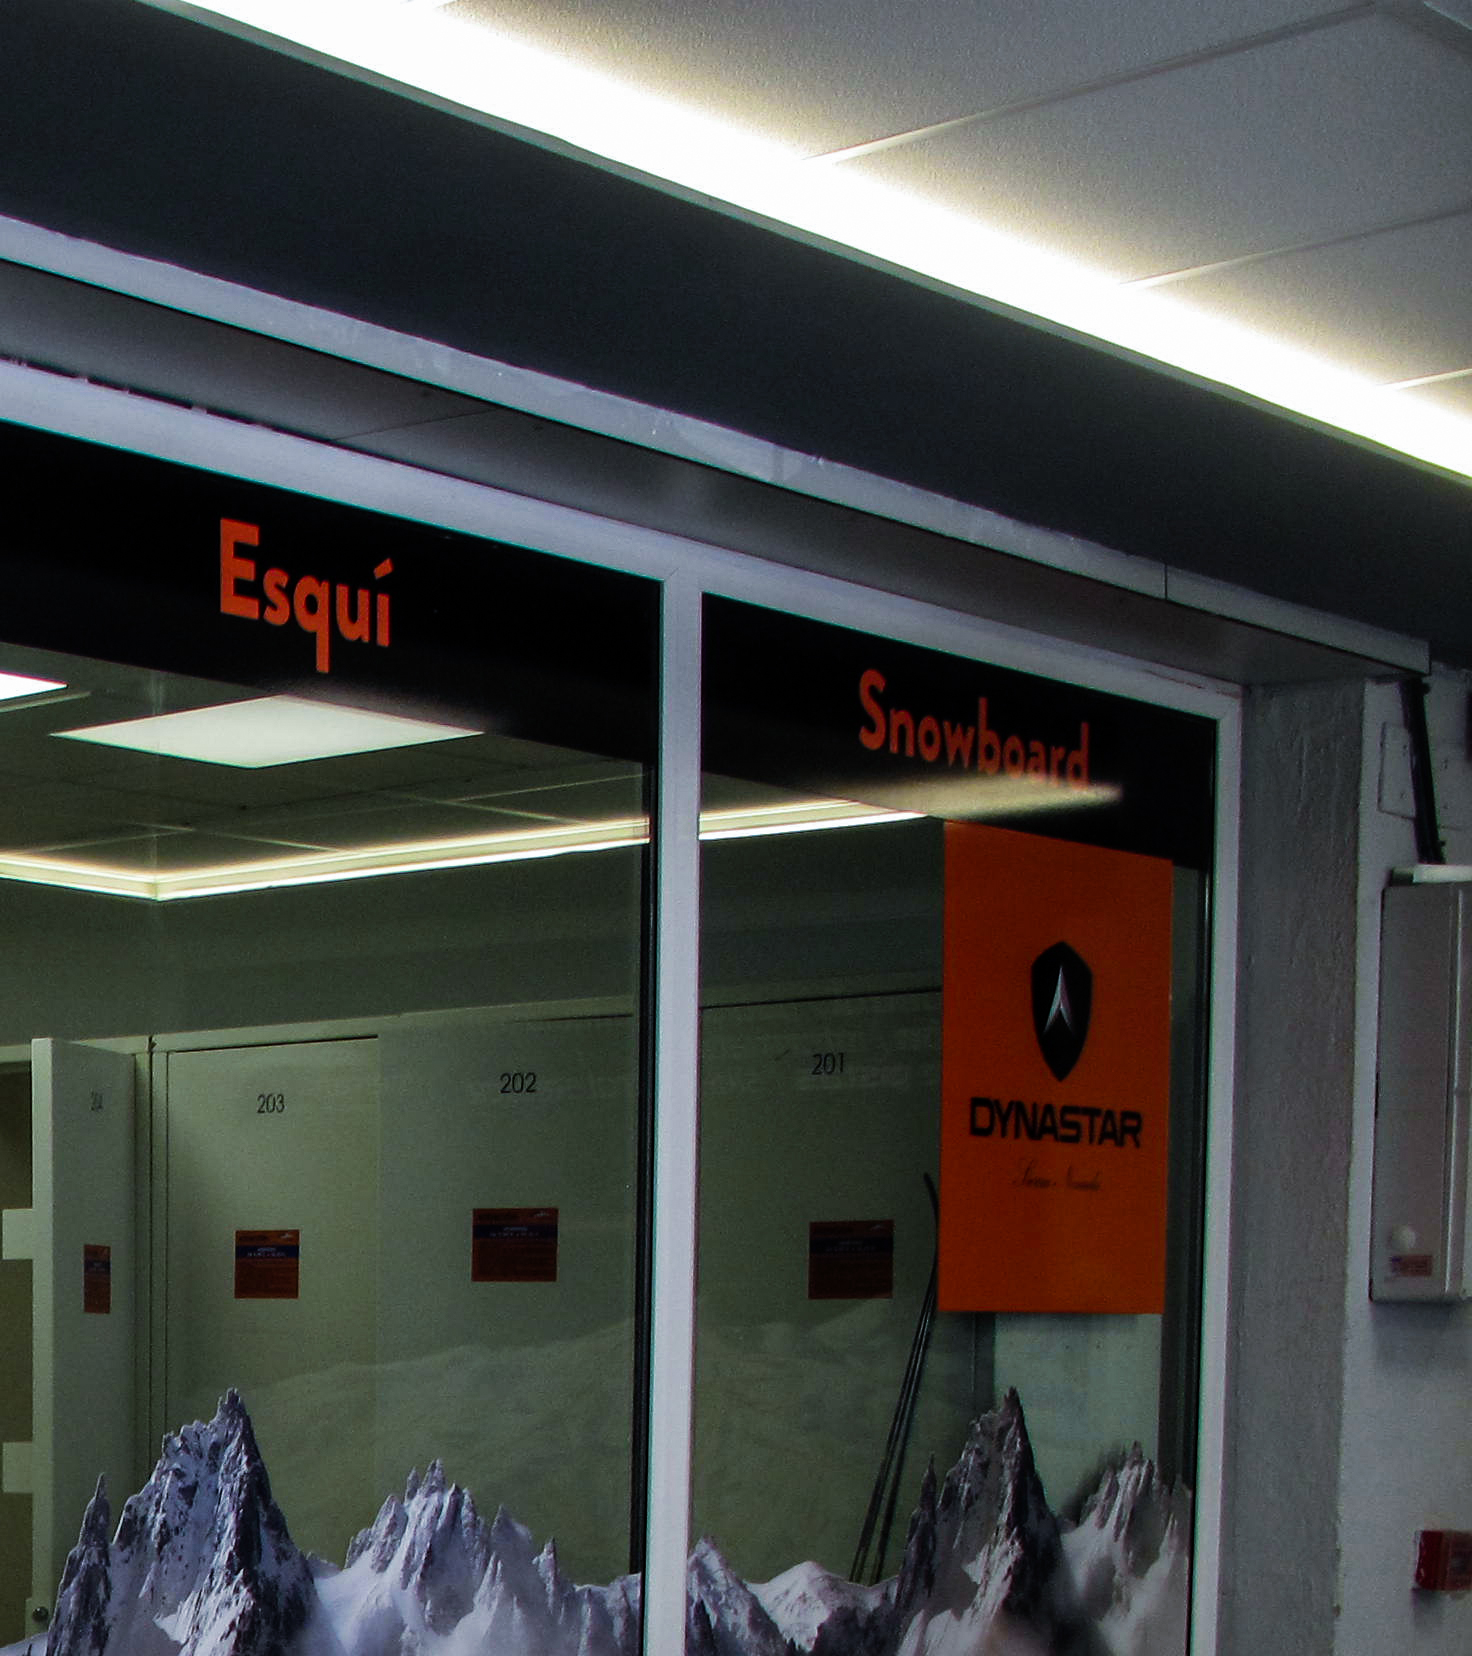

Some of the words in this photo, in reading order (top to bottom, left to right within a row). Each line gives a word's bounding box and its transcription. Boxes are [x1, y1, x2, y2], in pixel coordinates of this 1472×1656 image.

[219, 517, 394, 674] Esquí
[859, 668, 1091, 791] Snowboard
[811, 1052, 844, 1075] 201
[500, 1071, 537, 1094] 202
[257, 1093, 285, 1114] 203
[969, 1096, 1143, 1148] DYNASTAR
